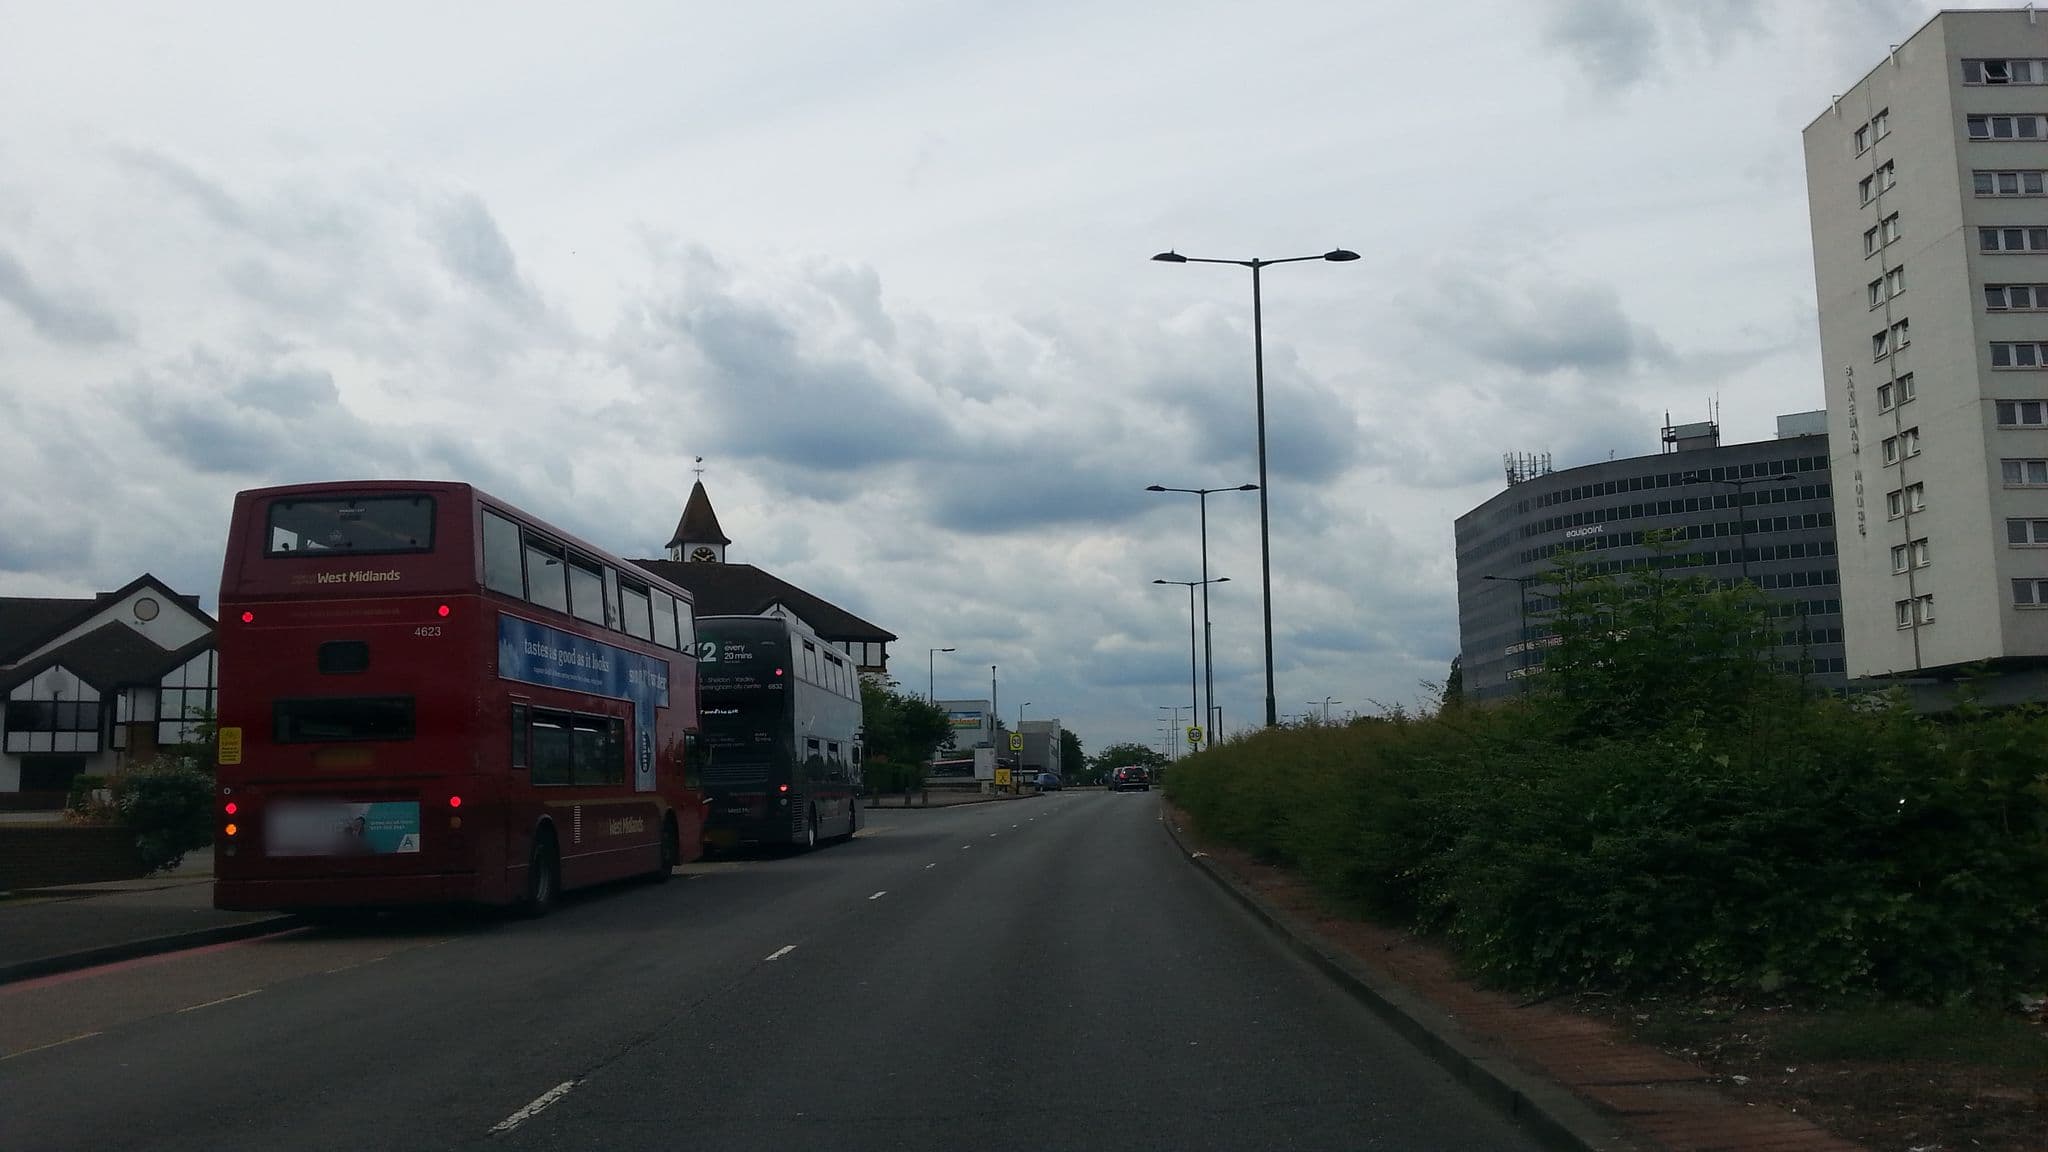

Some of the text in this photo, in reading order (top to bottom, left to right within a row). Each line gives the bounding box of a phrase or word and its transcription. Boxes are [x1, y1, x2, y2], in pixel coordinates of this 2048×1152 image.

[1566, 525, 1604, 538] equipoint
[317, 572, 347, 584] West
[348, 570, 401, 583] Midlands
[413, 626, 442, 637] 4623
[524, 637, 548, 657] tastes
[558, 649, 576, 666] good
[576, 655, 585, 667] as
